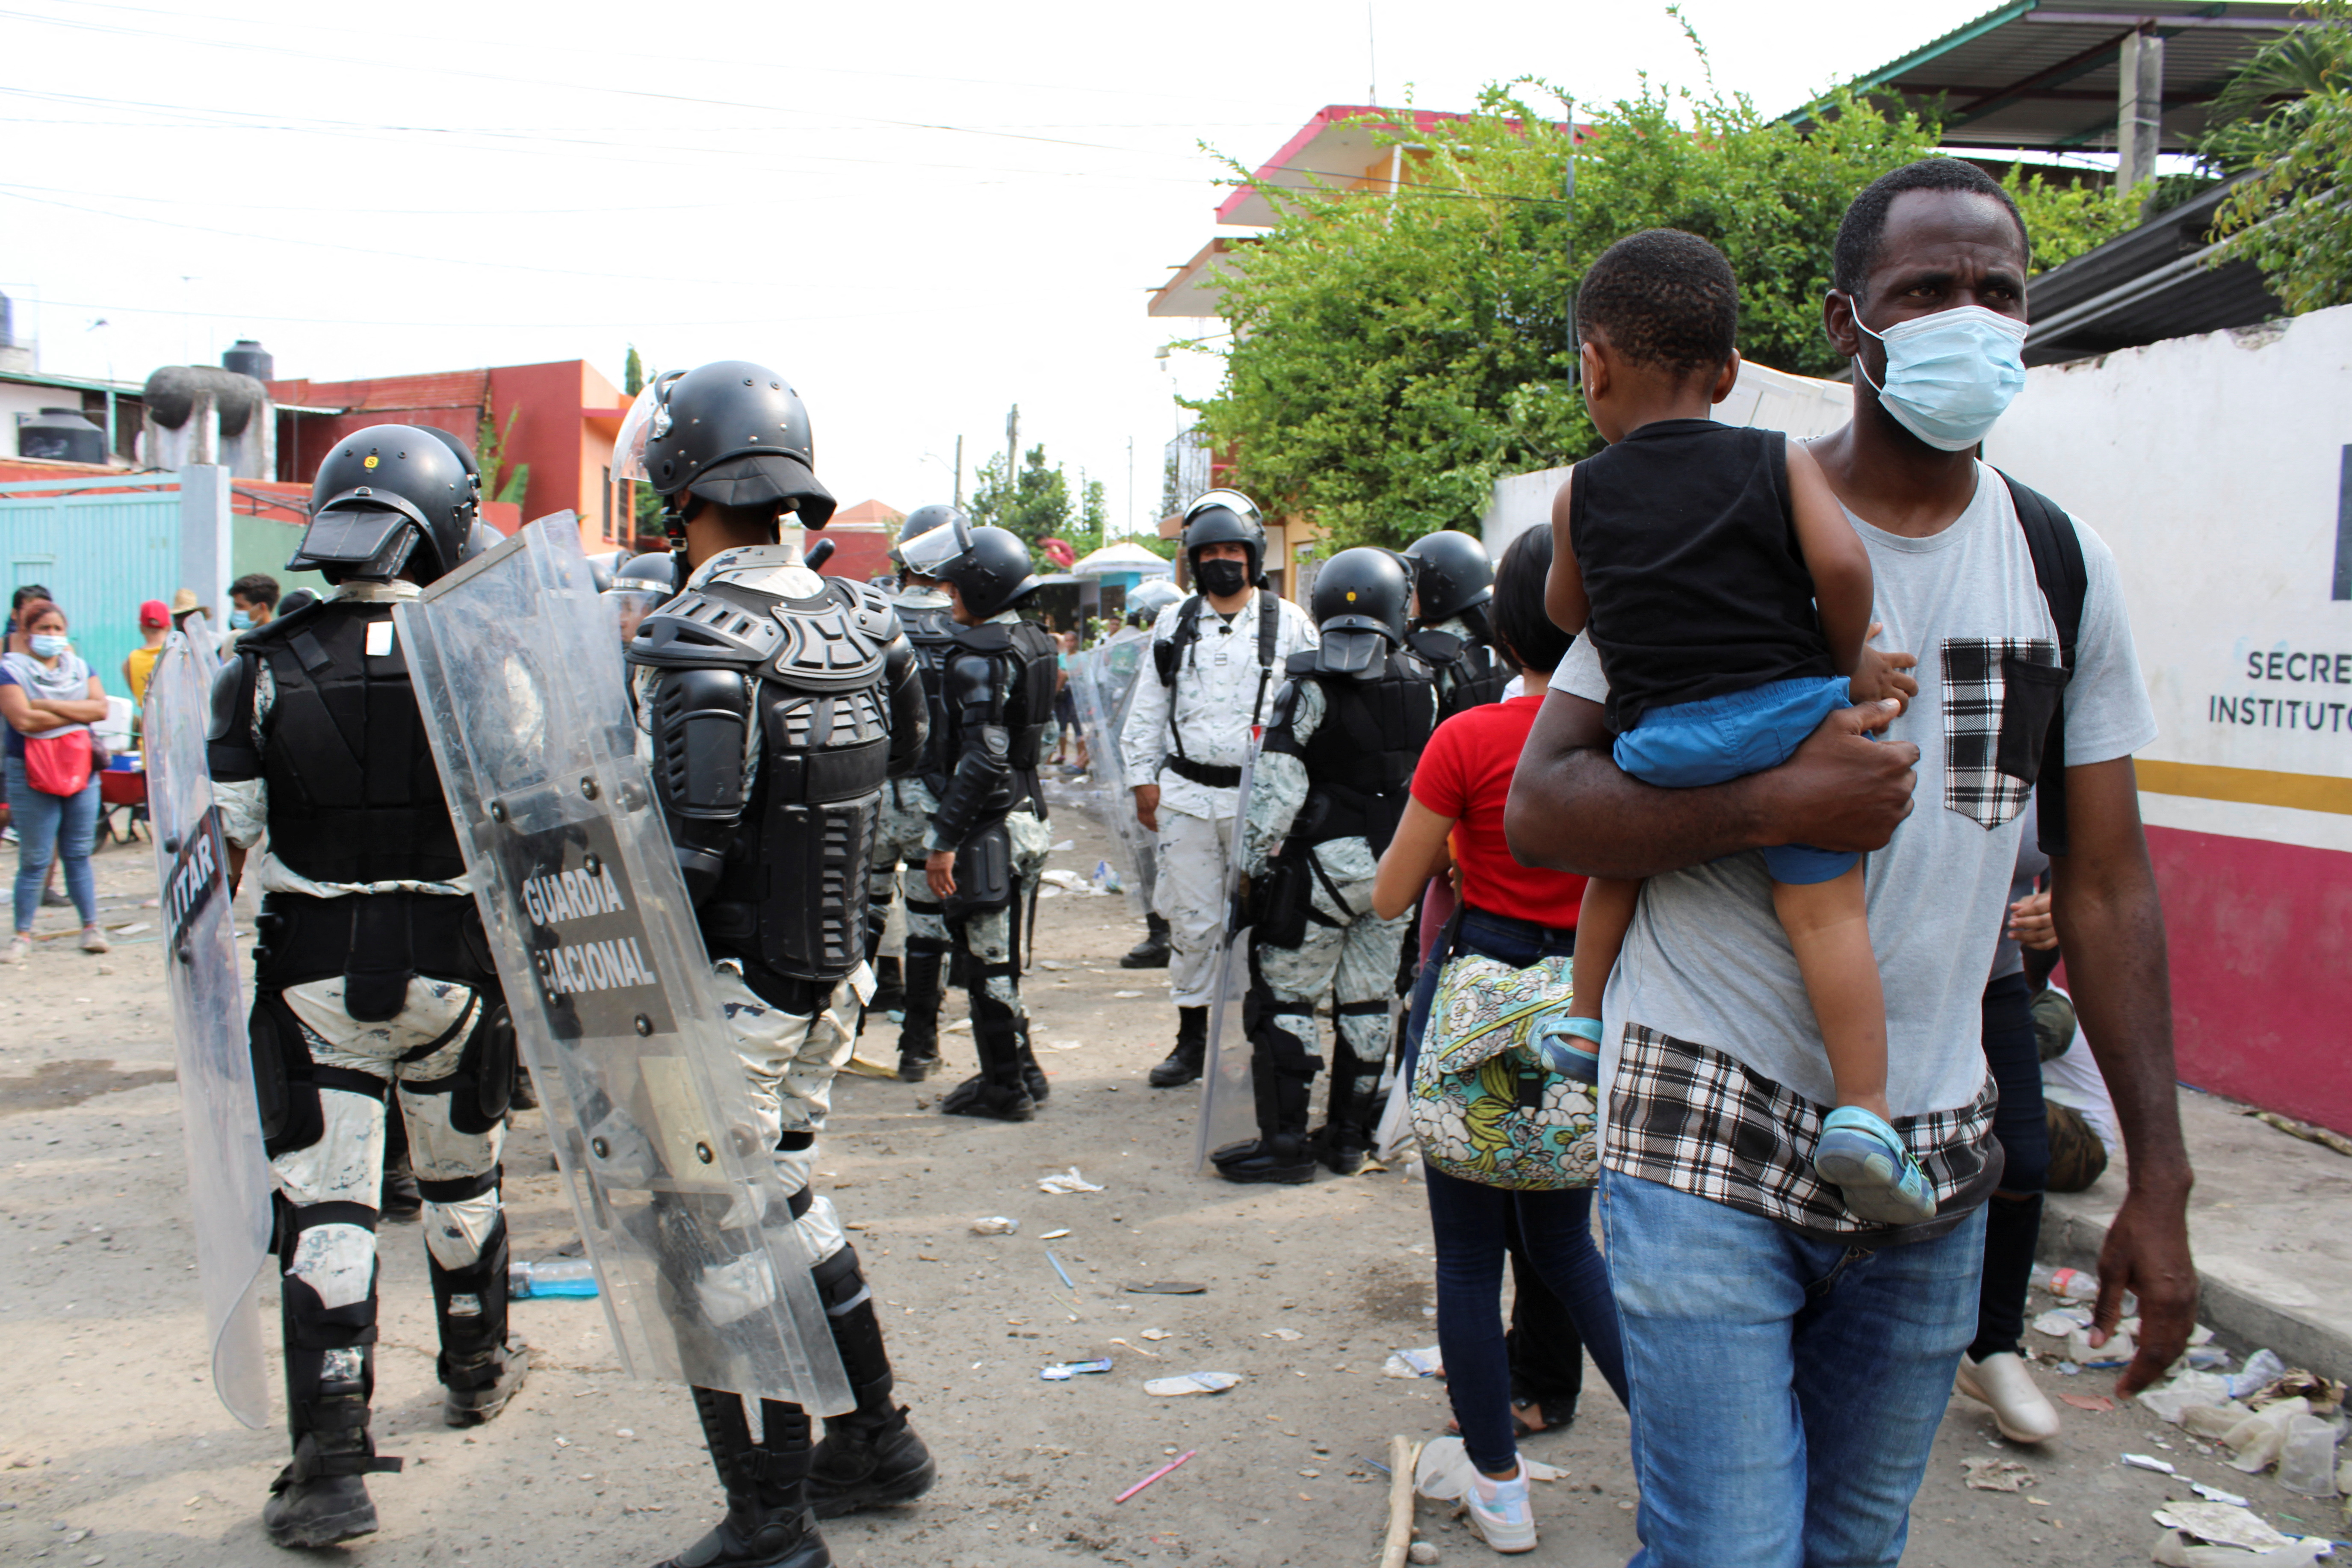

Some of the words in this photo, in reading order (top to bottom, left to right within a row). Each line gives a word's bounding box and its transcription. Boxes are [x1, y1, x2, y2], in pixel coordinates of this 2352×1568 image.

[2247, 651, 2352, 684] SECRE
[2210, 695, 2352, 732] INSTITUT
[523, 863, 625, 926] GUARDIA
